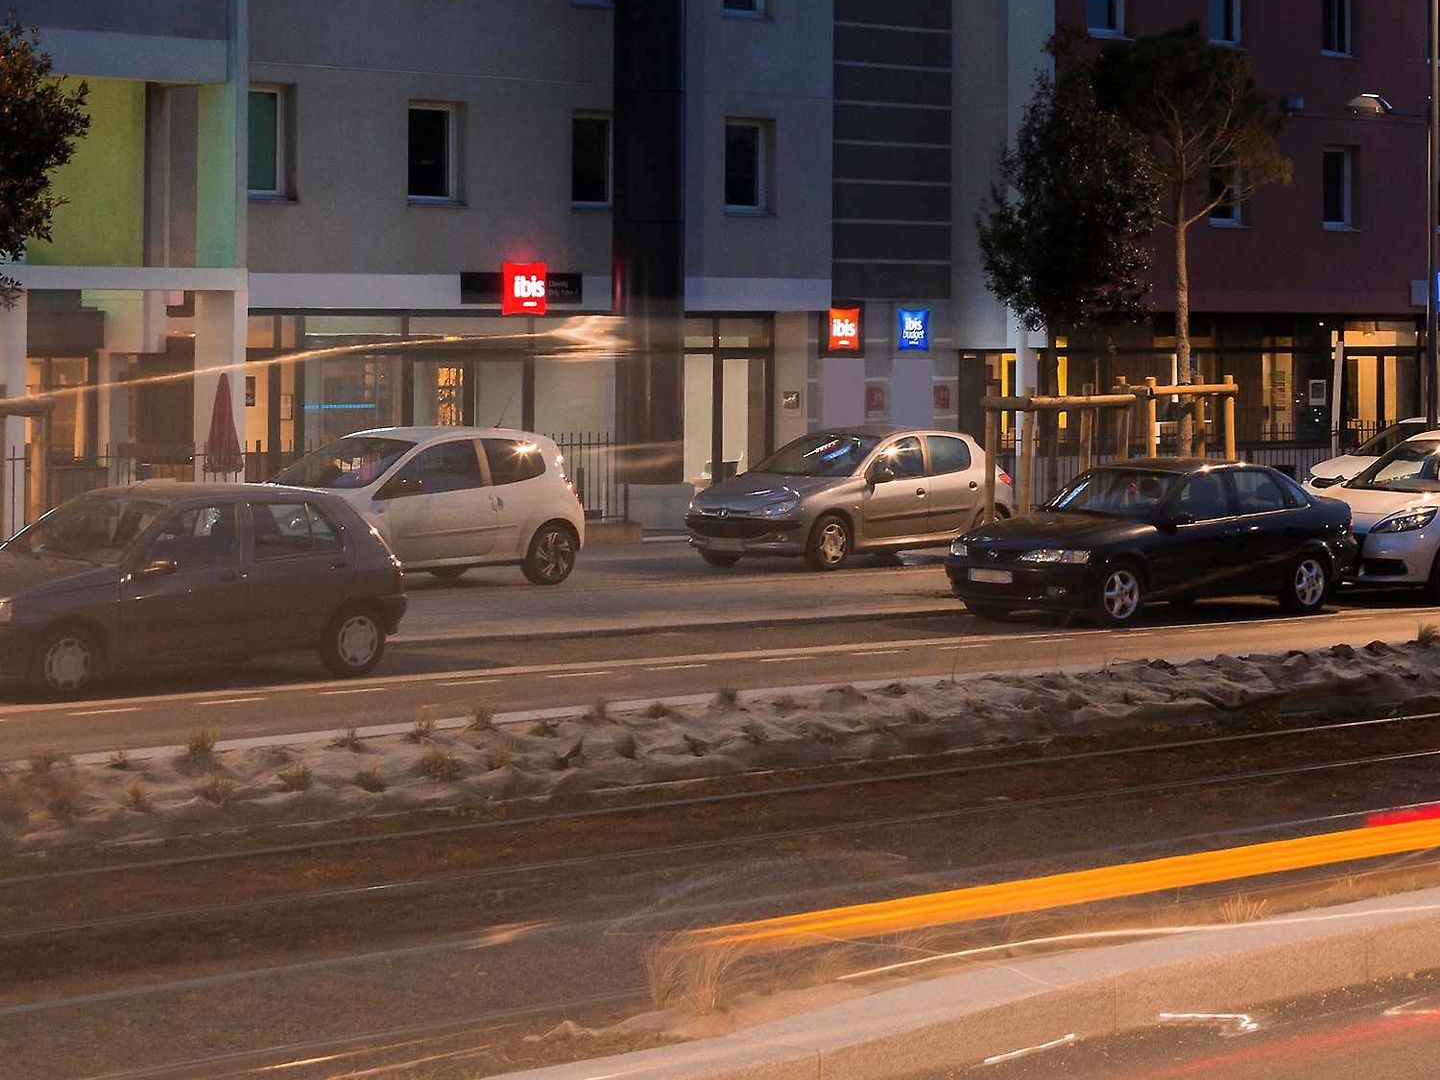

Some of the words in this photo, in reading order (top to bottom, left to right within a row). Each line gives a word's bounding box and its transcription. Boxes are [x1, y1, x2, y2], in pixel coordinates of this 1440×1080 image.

[514, 275, 546, 298] ibis
[833, 318, 856, 337] ibis
[905, 317, 923, 331] ibis
[902, 329, 925, 341] budget
